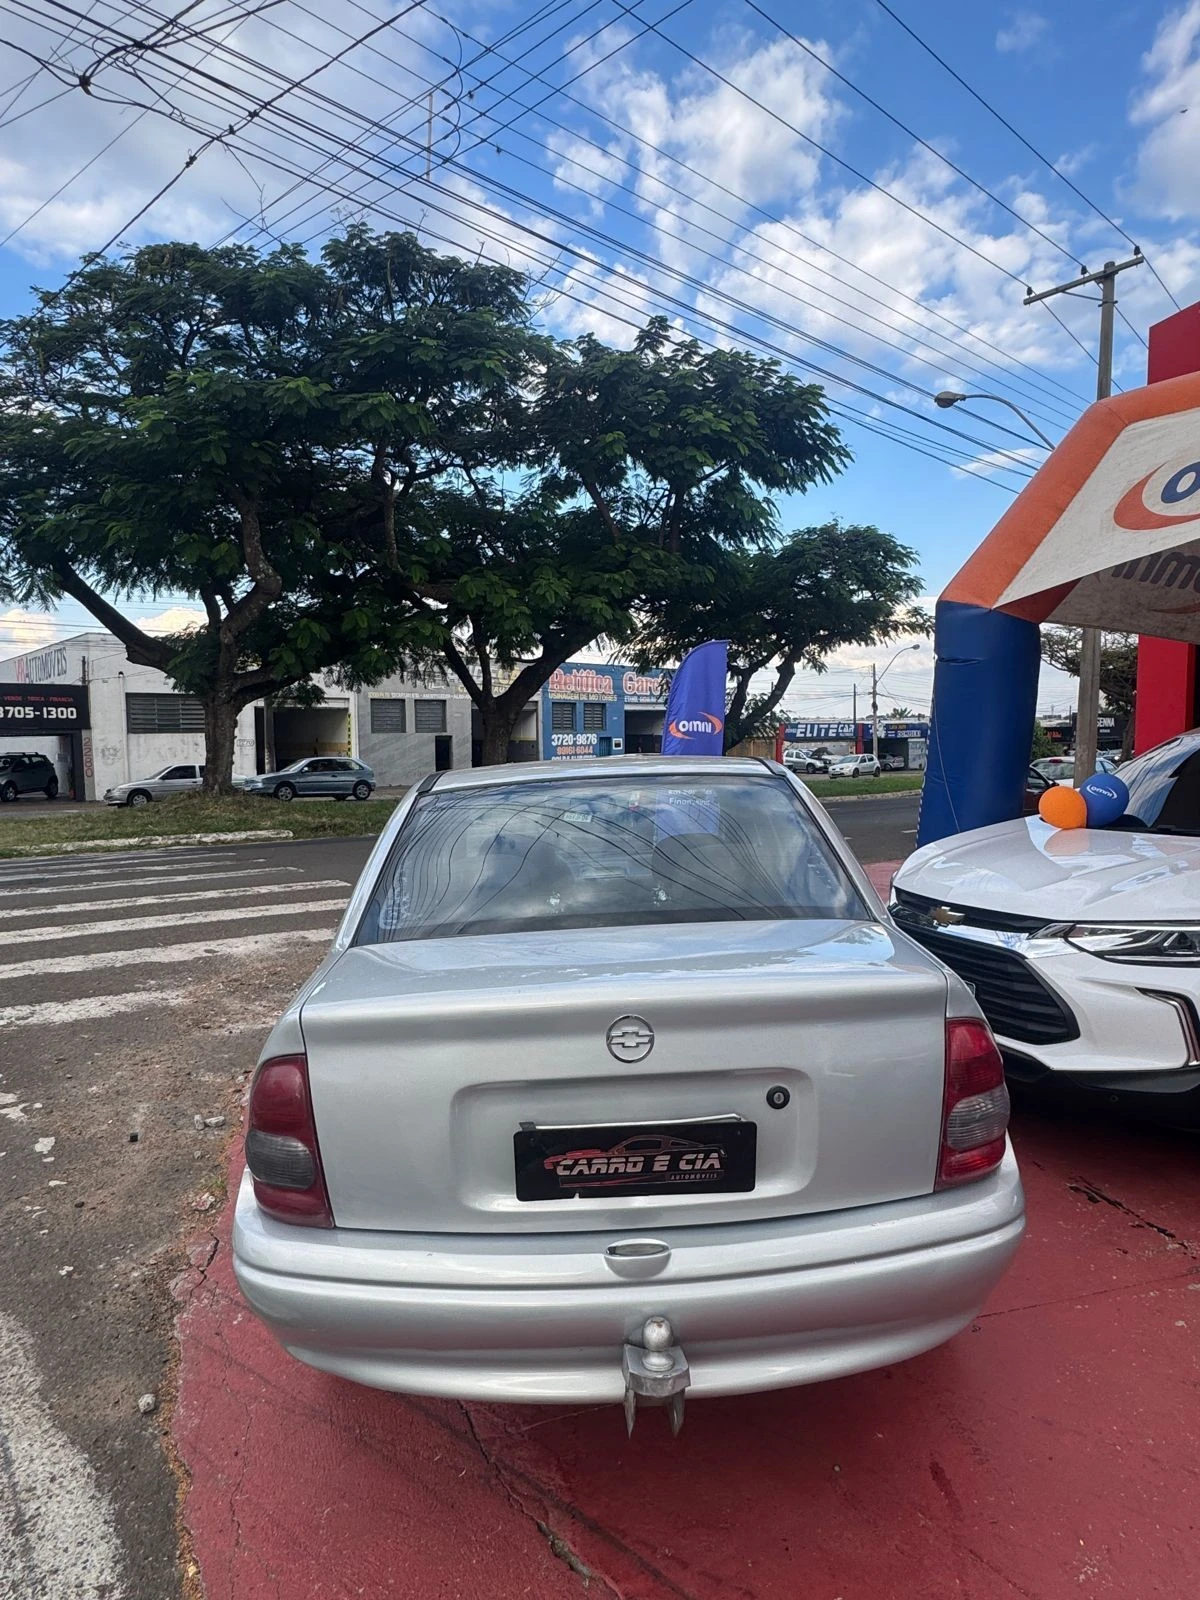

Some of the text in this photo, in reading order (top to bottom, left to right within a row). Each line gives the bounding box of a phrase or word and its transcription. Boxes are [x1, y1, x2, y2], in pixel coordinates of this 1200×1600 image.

[678, 720, 712, 734] omni
[796, 724, 837, 738] ELITE
[551, 733, 598, 746] 3720-9876
[1090, 786, 1113, 797] omni
[556, 1156, 645, 1176] CARRO
[652, 1155, 672, 1172] E
